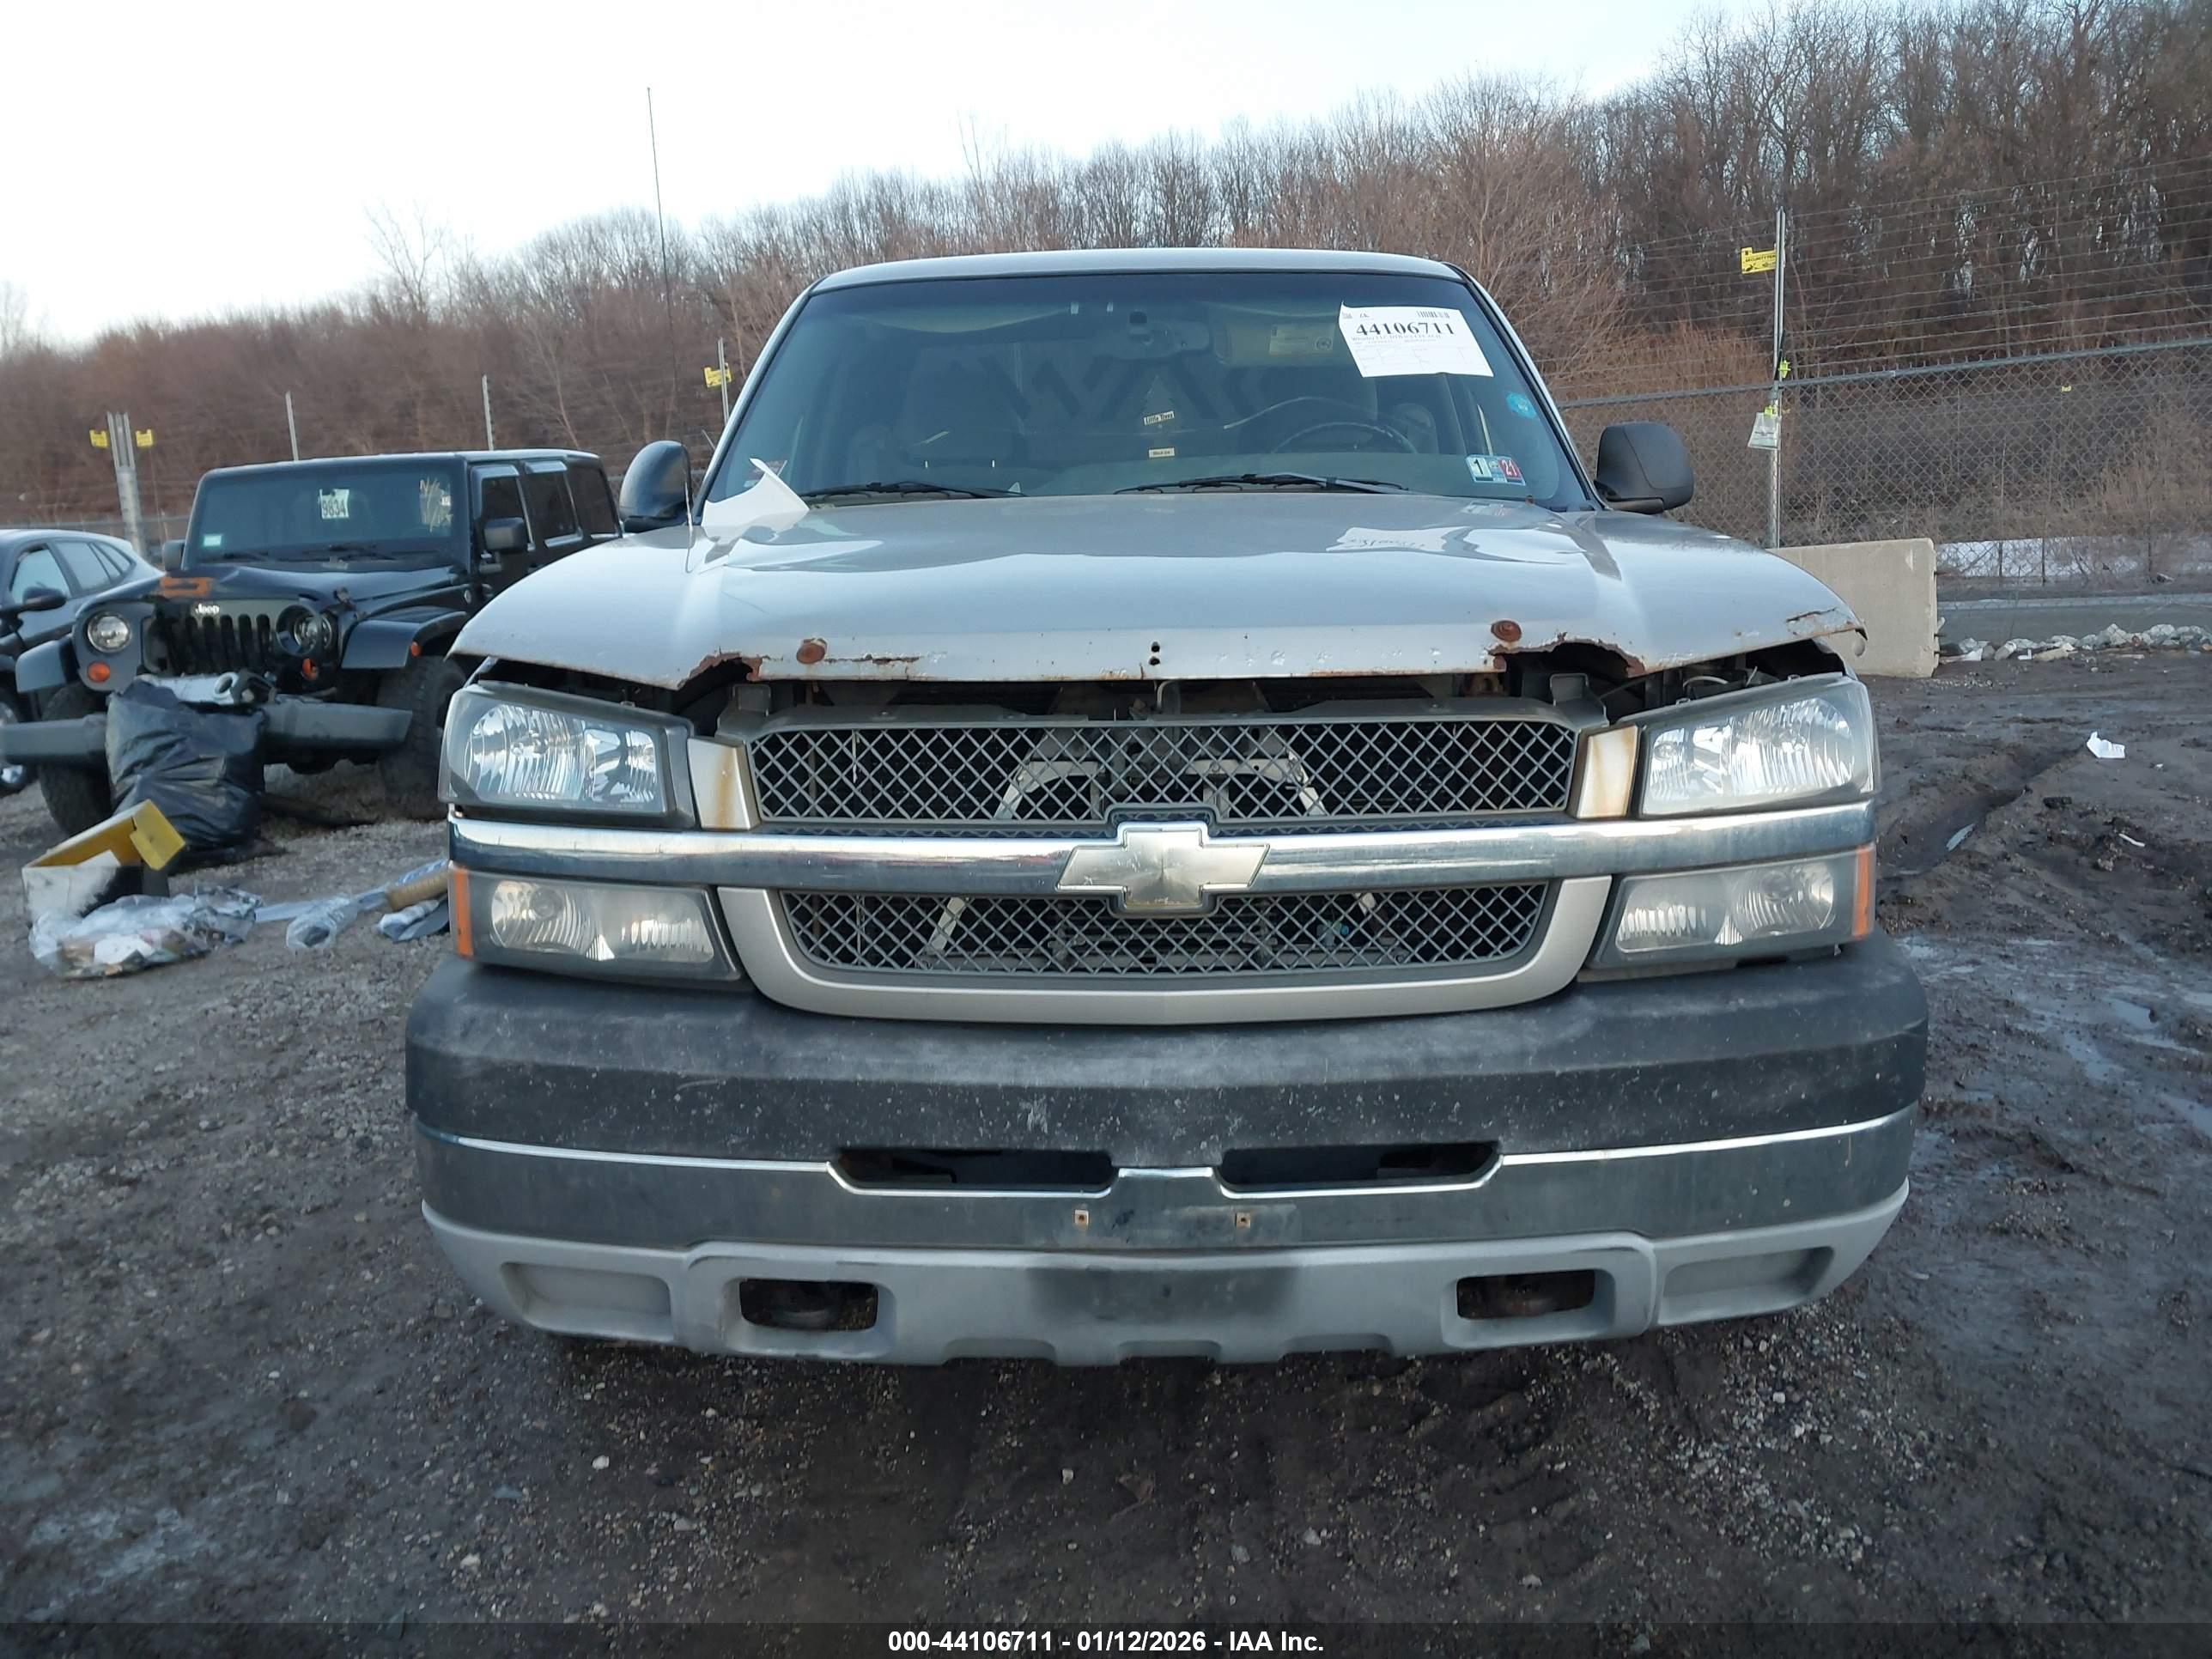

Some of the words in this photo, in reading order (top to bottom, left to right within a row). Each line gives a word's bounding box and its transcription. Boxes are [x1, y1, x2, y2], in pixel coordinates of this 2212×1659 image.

[1356, 321, 1455, 336] 44106711
[1473, 458, 1484, 475] 1
[195, 603, 220, 615] Jeep
